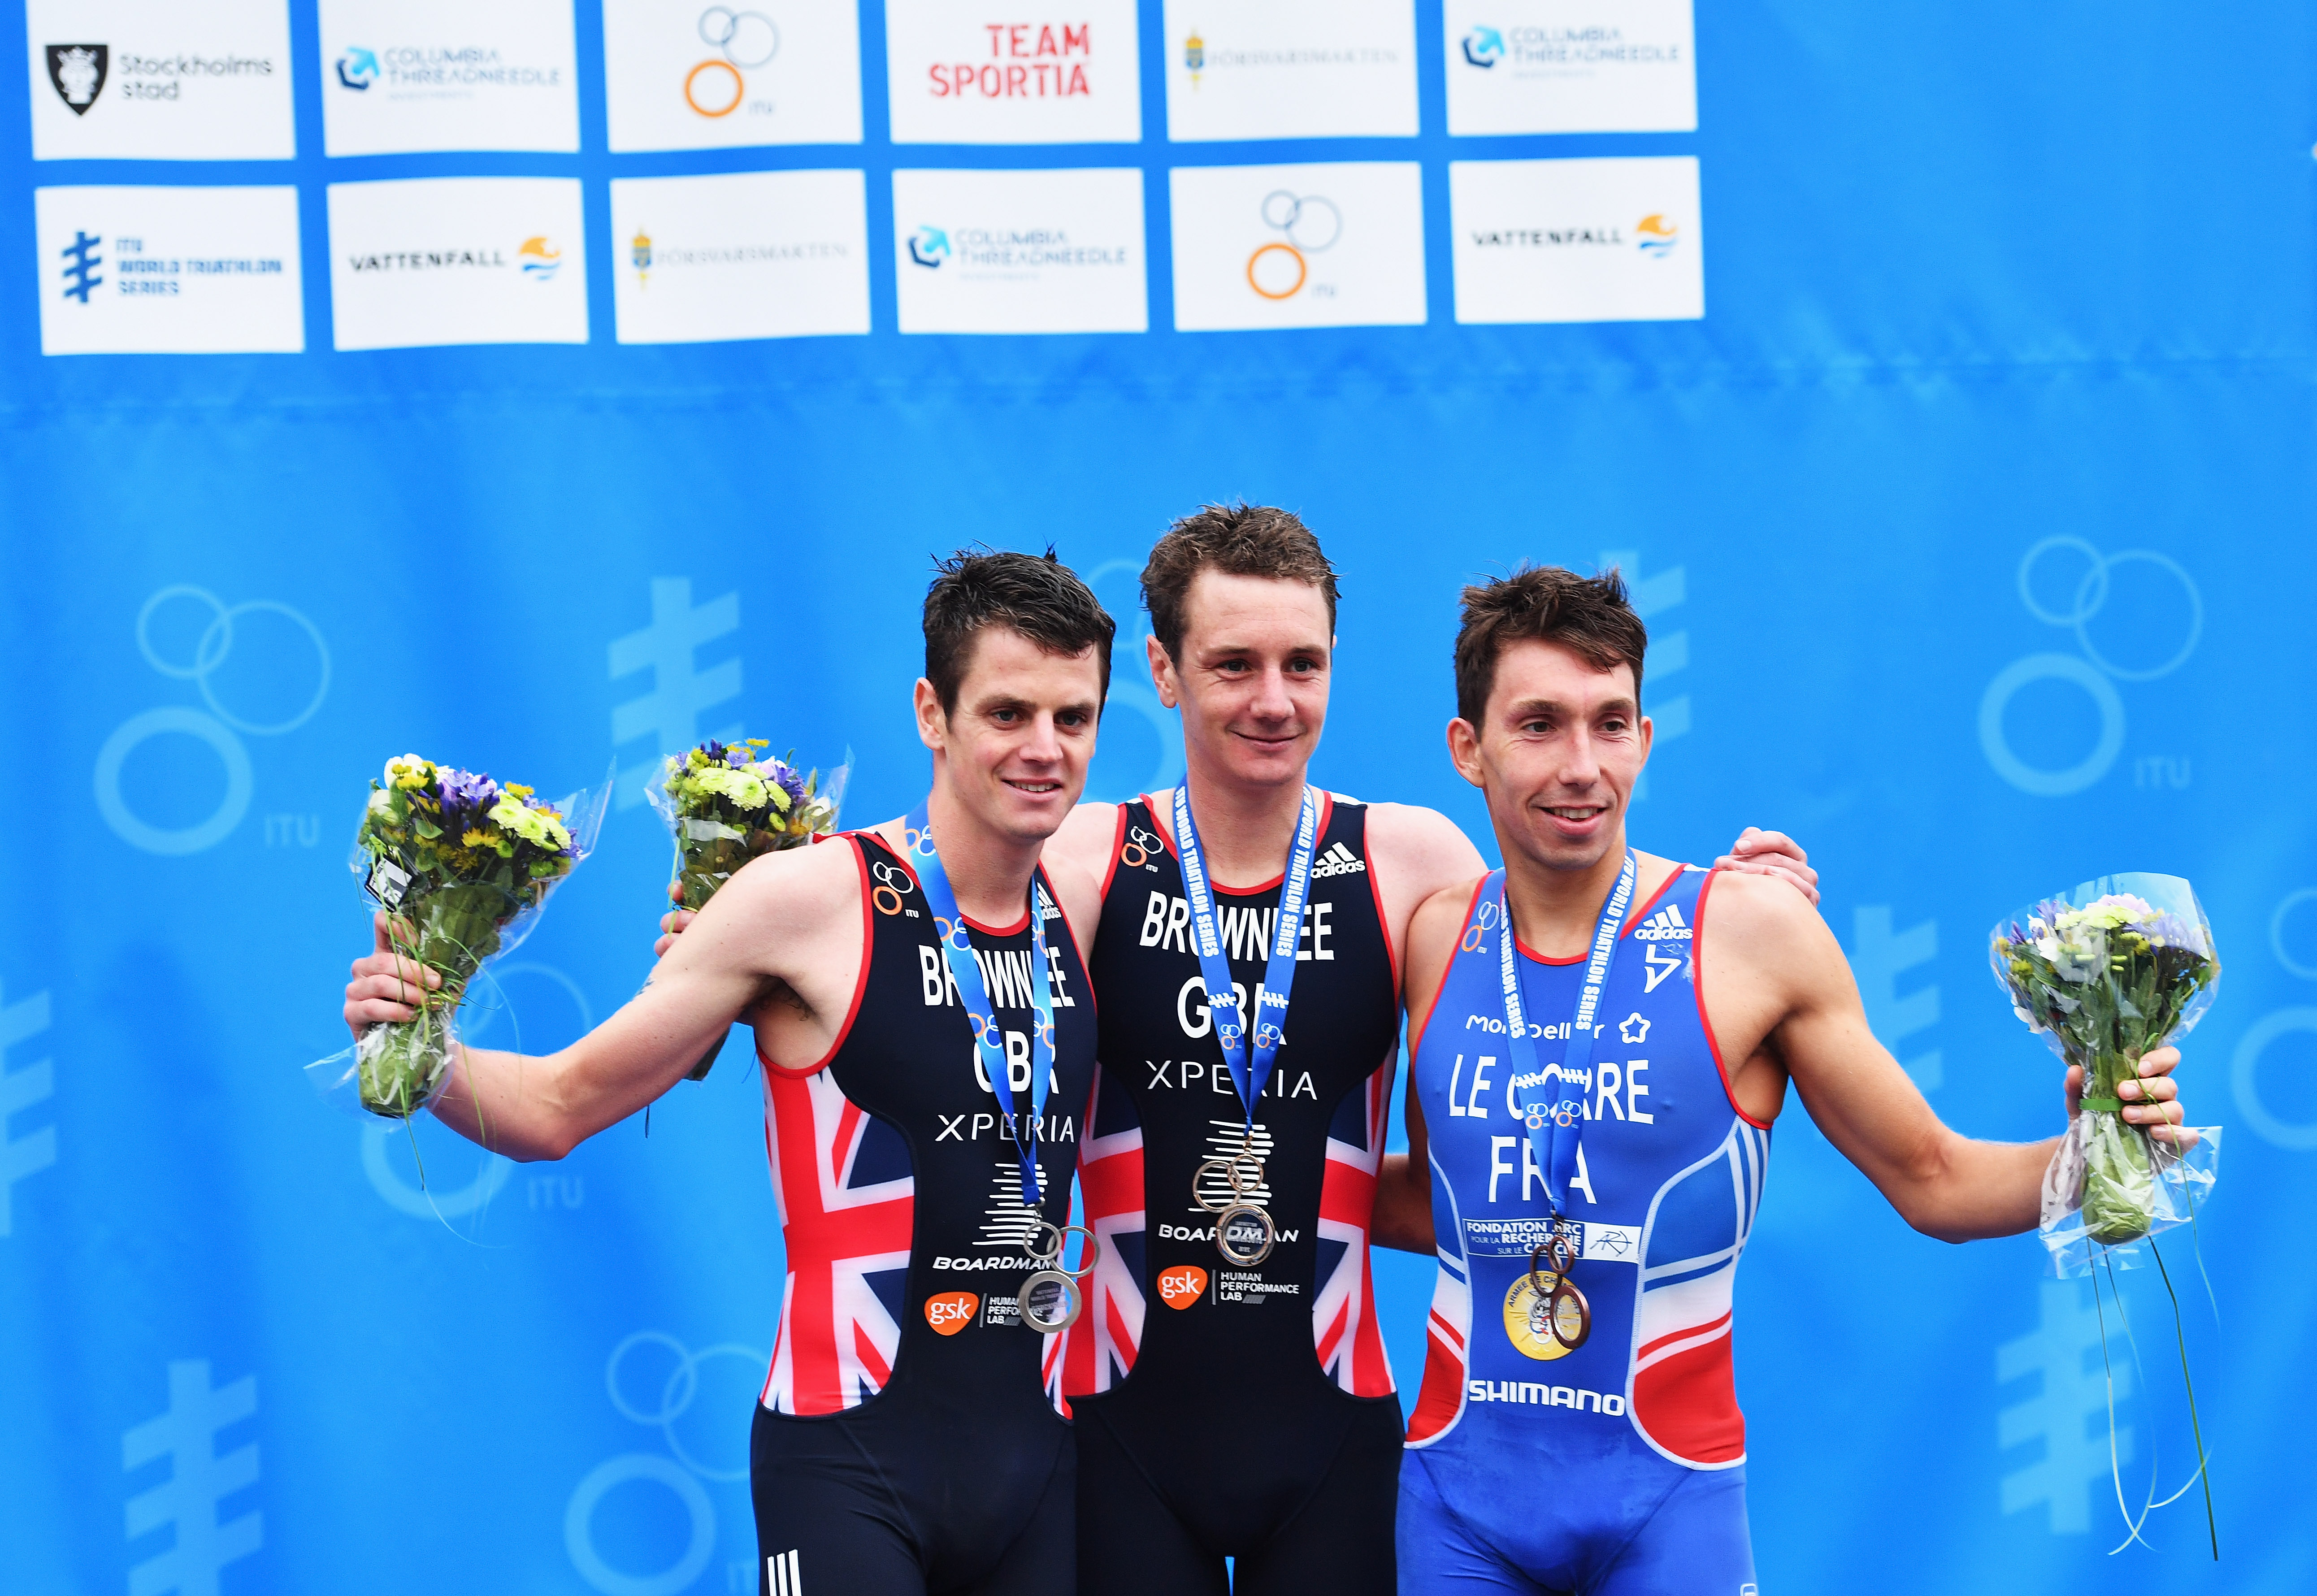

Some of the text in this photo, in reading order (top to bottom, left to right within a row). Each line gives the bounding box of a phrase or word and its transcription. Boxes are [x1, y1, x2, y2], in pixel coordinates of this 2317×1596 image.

[986, 24, 1090, 57] TEAM
[1510, 27, 1623, 44] COLUMBIA
[119, 53, 273, 77] Stockholms
[384, 48, 500, 65] COLUMBIA
[1514, 46, 1679, 63] THREADNEEDLE
[389, 68, 561, 86] THREADNEEDLE
[930, 64, 1091, 98] SPORTIA
[122, 79, 179, 101] stad
[116, 238, 142, 252] ITU
[955, 229, 1068, 246] COLUMBIA
[1472, 228, 1623, 247] VATTENFALL
[117, 259, 282, 274] WORLD TRIATHLON
[349, 250, 506, 273] VATTENFALL
[960, 247, 1126, 265] THREADNEEDLE
[118, 281, 179, 297] SERIES
[2134, 758, 2191, 789] ITU
[265, 815, 319, 846] ITU
[1176, 805, 1195, 850] WORLD
[1297, 804, 1314, 849] WORLD
[1310, 858, 1365, 879] adidas
[1182, 849, 1210, 914] TRIATHLON
[1284, 849, 1310, 914] TRIATHLON
[1607, 874, 1634, 918] WORLD
[905, 909, 919, 918] ITU
[1196, 914, 1219, 958] SERIES
[1276, 914, 1298, 958] SERIES
[1635, 927, 1693, 941] adidas
[1586, 918, 1620, 984] TRIATHLON
[1505, 993, 1526, 1039] SERIES
[1575, 985, 1600, 1031] SERIES
[1145, 1060, 1318, 1100] XPEIA
[1449, 1054, 1497, 1119] LE
[935, 1113, 1074, 1143] XPERIA
[528, 1177, 583, 1208] ITU
[1467, 1222, 1547, 1232] FONDATION
[933, 1257, 1052, 1271] BOARDMAN
[1161, 1272, 1202, 1298] gsk
[1220, 1272, 1262, 1282] HUMAN
[1220, 1282, 1299, 1294] PERFORMANCE
[1220, 1292, 1242, 1301] LAB
[930, 1297, 972, 1325] gsk
[987, 1315, 1005, 1324] LAB
[1469, 1380, 1626, 1417] SHIMANO
